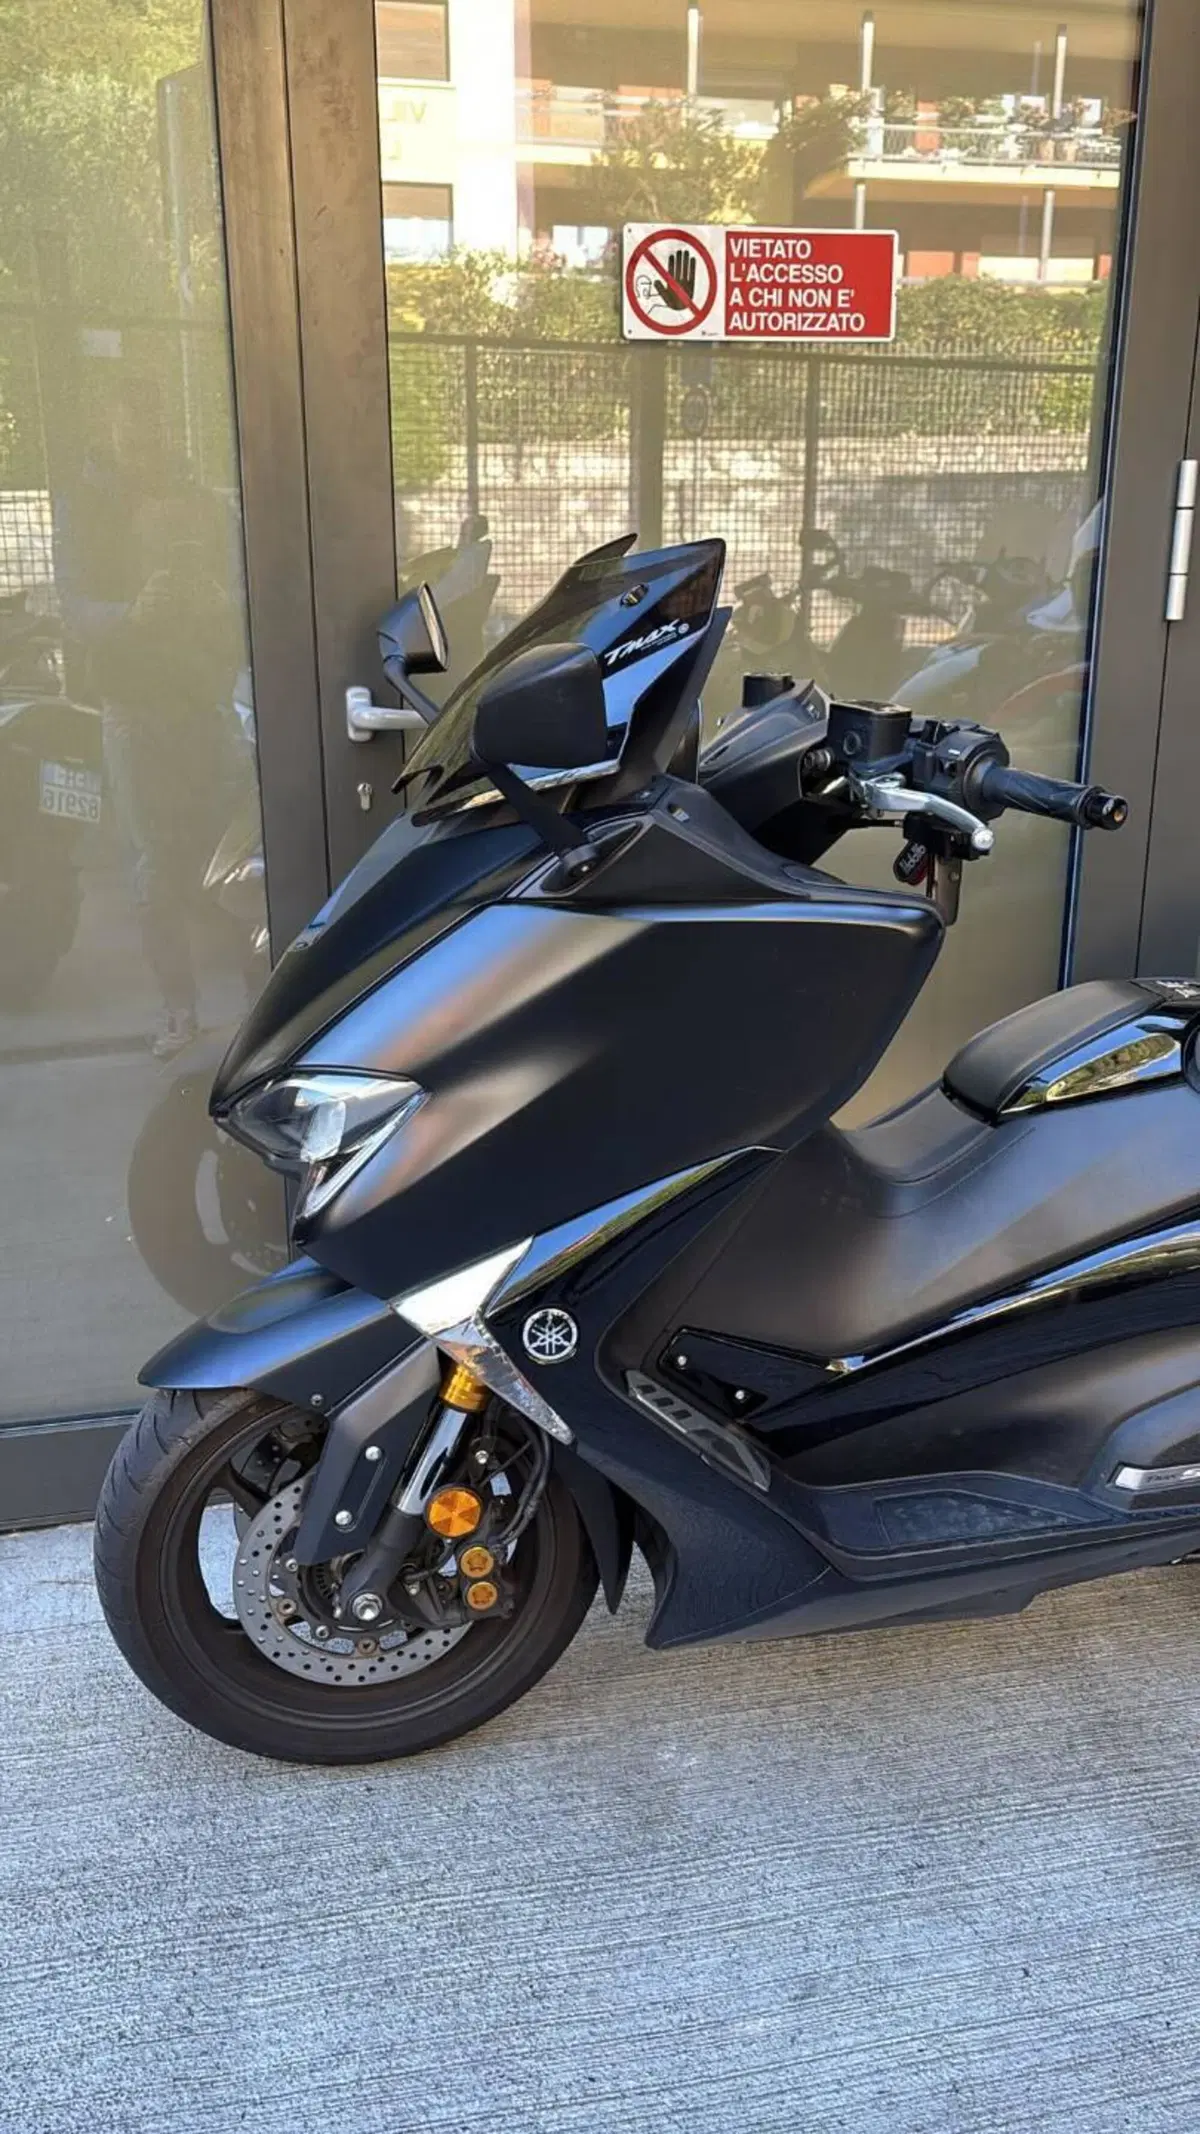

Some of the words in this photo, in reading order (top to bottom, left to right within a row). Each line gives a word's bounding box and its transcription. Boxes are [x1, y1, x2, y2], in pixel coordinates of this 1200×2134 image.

[729, 238, 812, 259] VIETATO
[729, 263, 844, 285] L'ACCESSO
[729, 289, 744, 307] A
[748, 289, 784, 308] CHI
[788, 289, 834, 308] NON
[837, 289, 855, 308] E'
[729, 312, 866, 332] AUTORIZZATO
